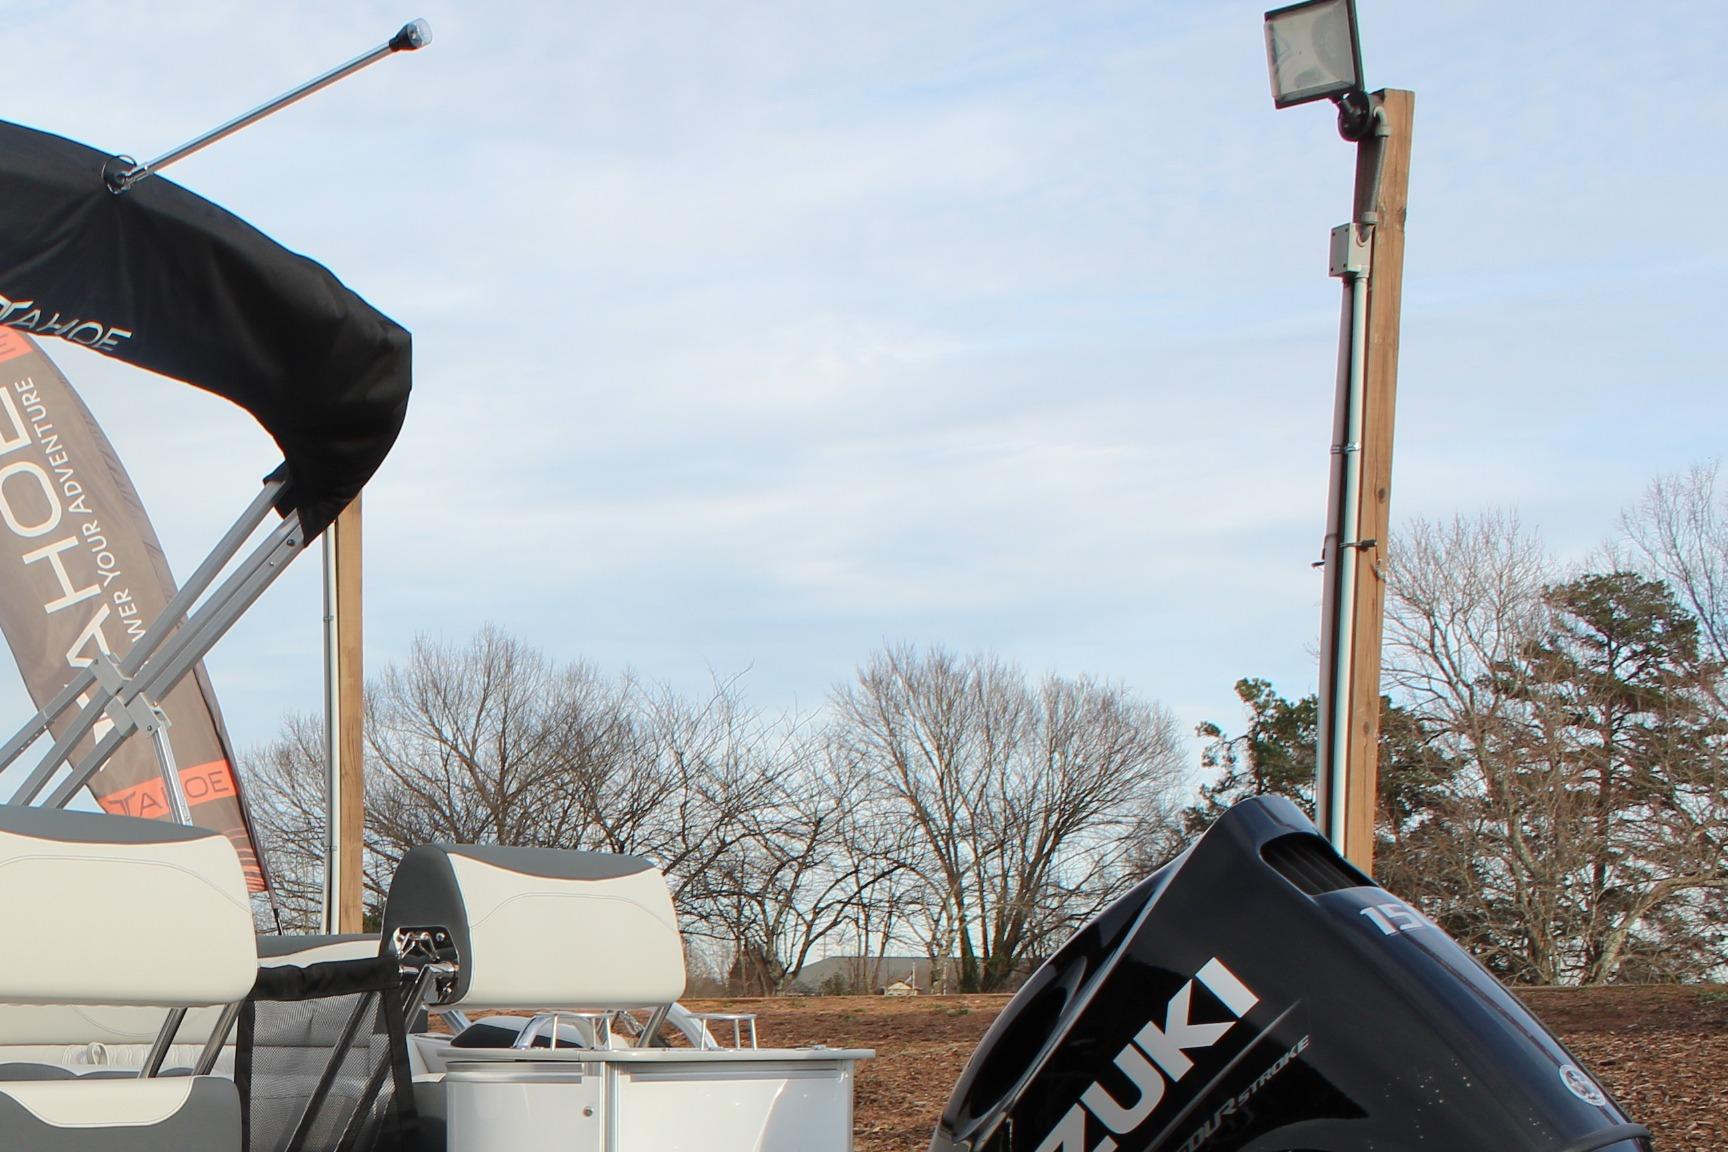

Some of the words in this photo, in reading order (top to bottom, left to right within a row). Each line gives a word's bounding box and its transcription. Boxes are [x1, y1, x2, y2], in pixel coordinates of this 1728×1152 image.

[14, 376, 93, 514] ADVENTURE
[82, 520, 121, 587] YOUR
[113, 588, 147, 643] WER
[108, 770, 229, 817] TAOE
[1237, 1034, 1311, 1107] STROKE
